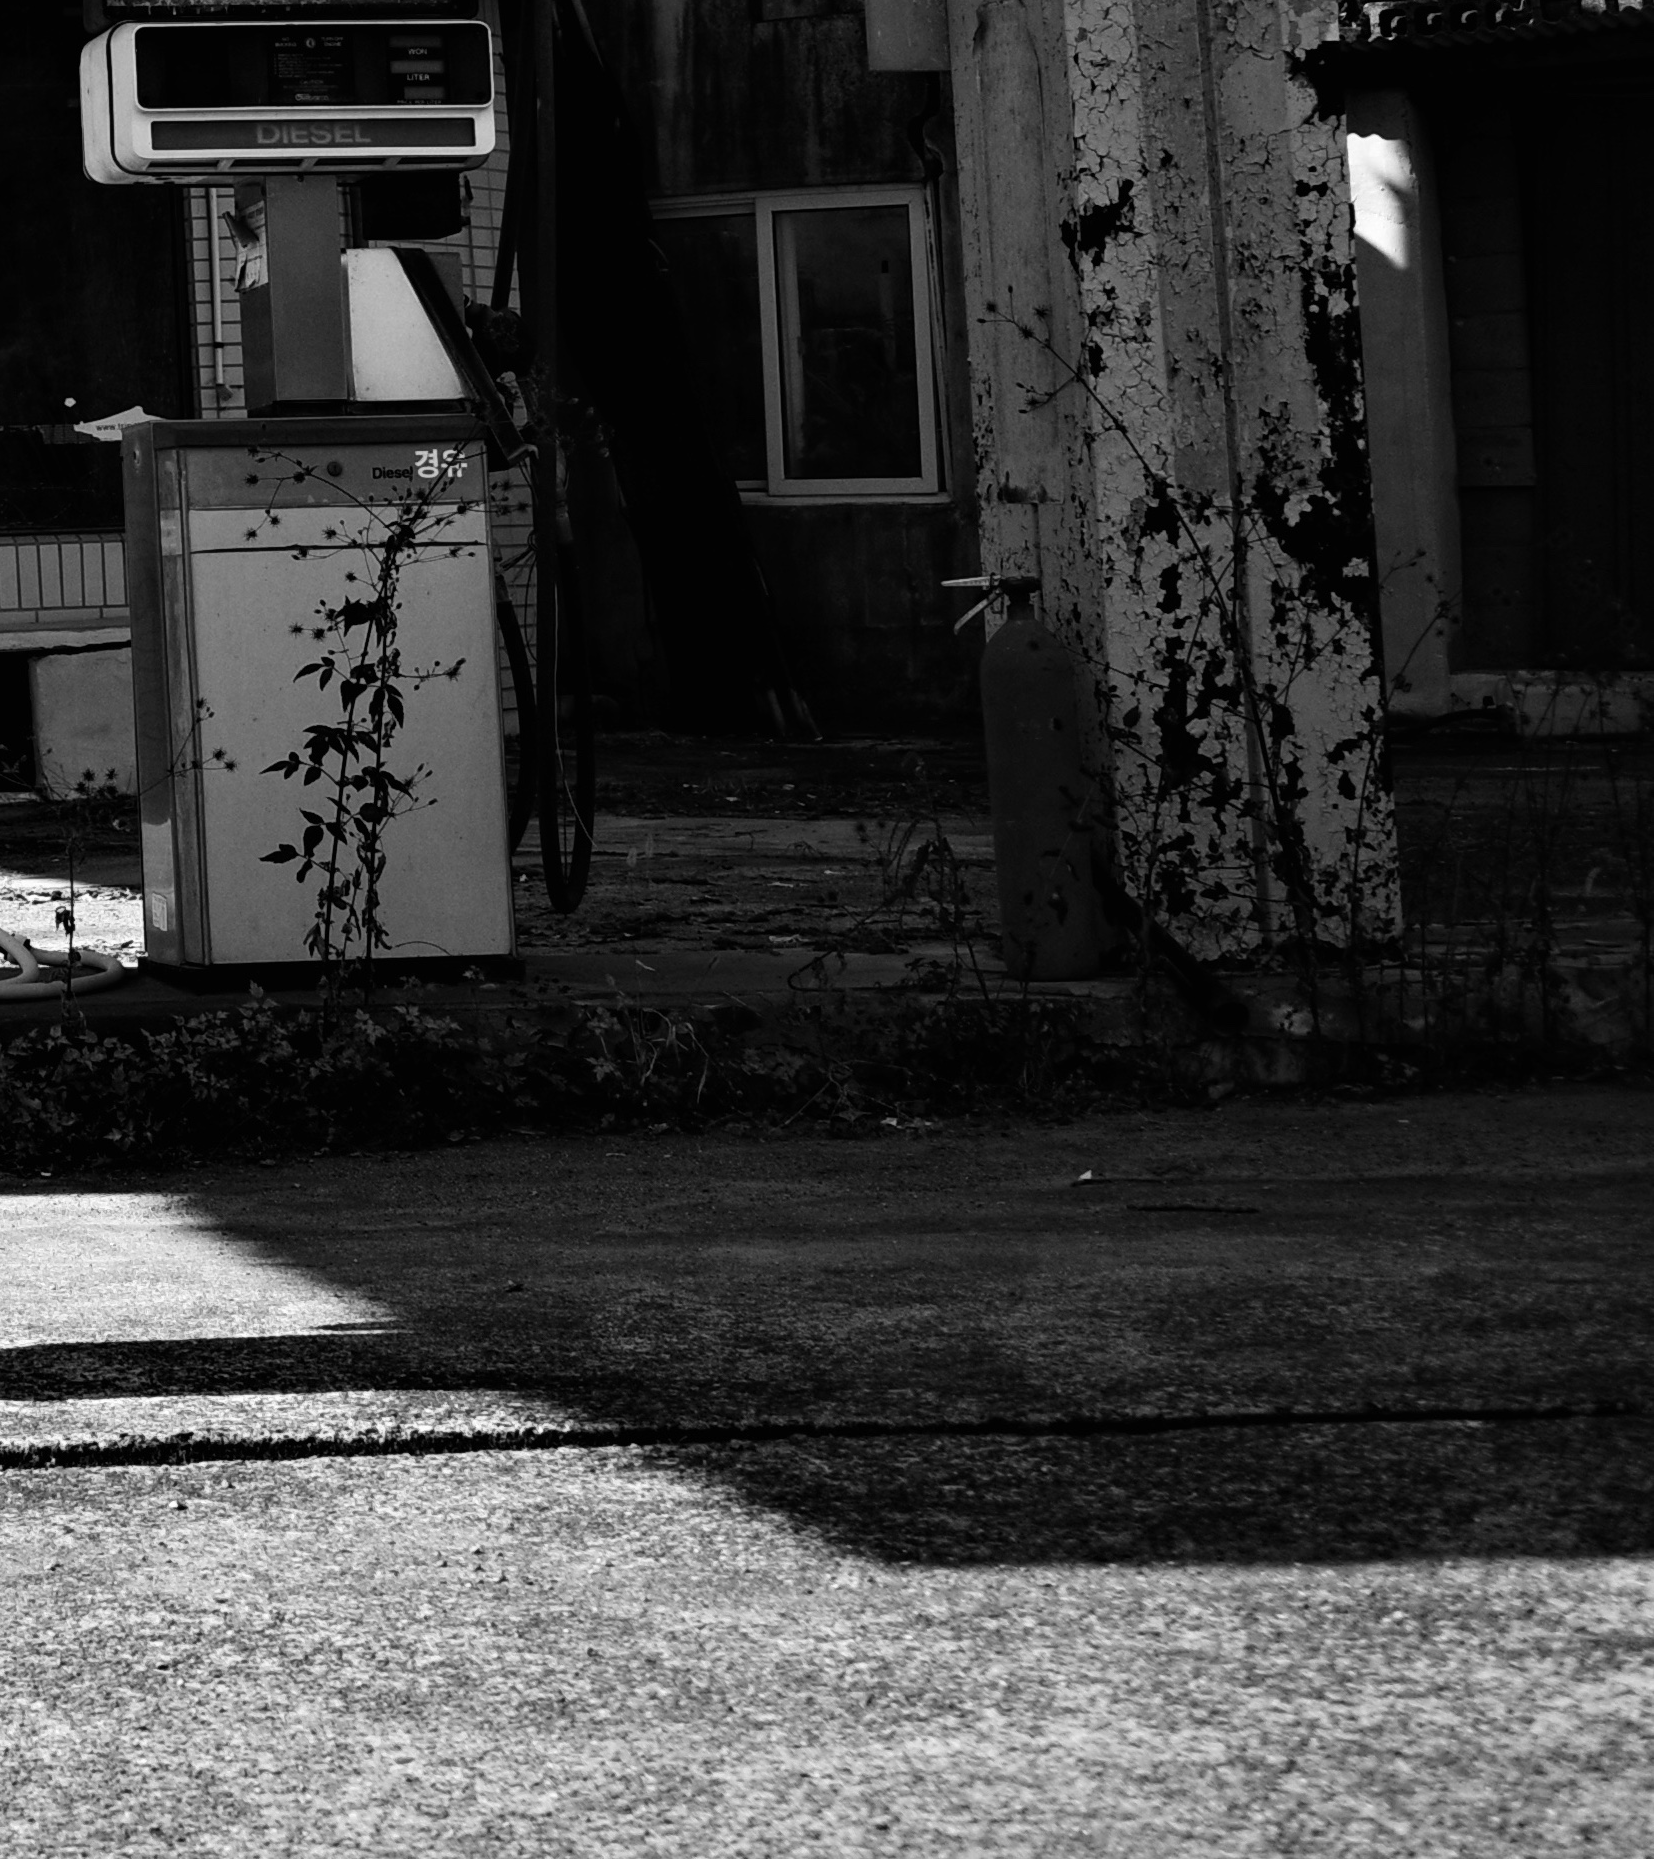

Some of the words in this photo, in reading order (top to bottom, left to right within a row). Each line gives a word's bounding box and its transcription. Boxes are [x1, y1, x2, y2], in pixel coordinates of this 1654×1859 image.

[256, 123, 372, 144] DIESEL
[372, 466, 413, 480] Diesel
[414, 448, 468, 479] 경유
